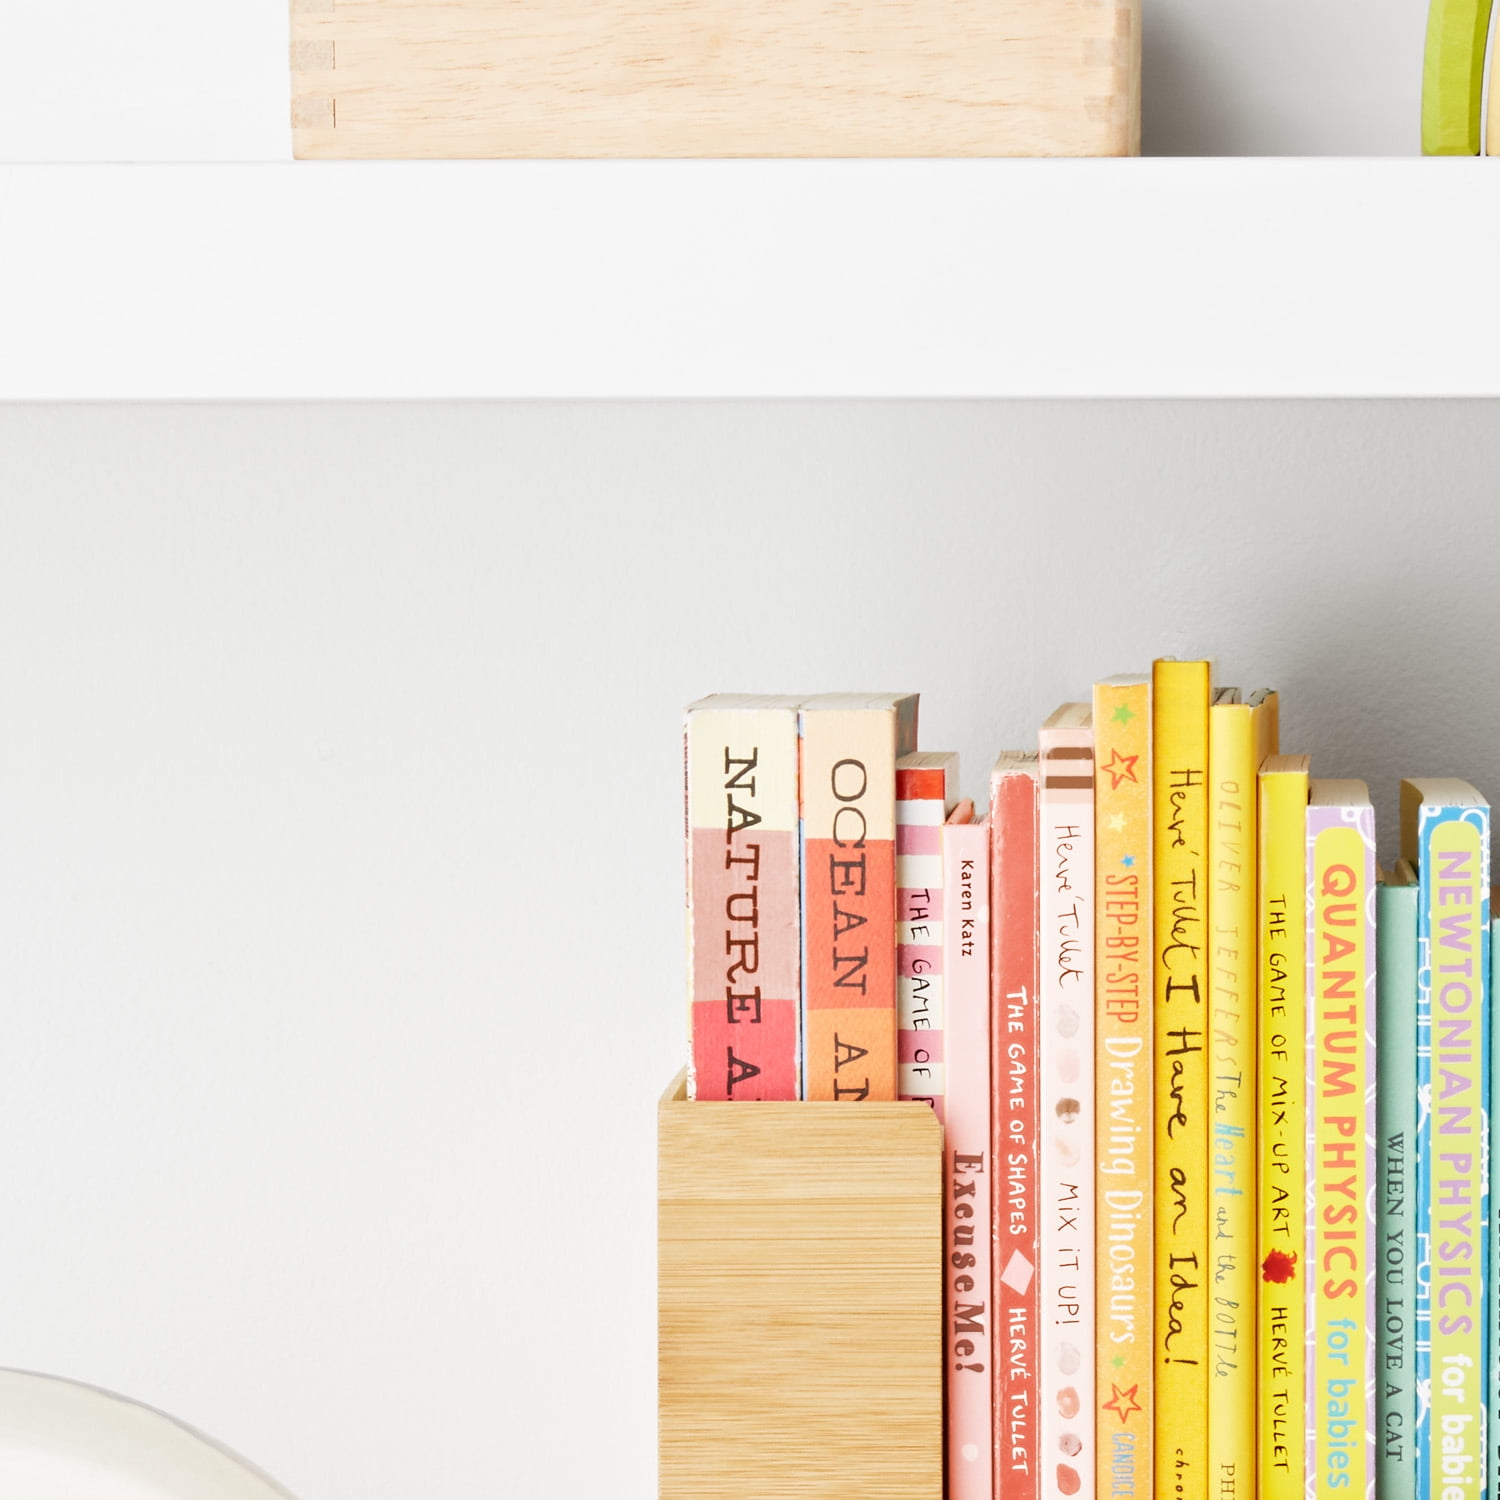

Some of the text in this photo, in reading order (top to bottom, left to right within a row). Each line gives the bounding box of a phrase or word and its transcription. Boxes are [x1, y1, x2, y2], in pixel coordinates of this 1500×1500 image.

[724, 746, 762, 1023] NATURE
[830, 758, 868, 996] OCEAN
[911, 888, 930, 940] THE
[960, 860, 975, 957] Karen Katz
[1269, 894, 1286, 940] THE
[1057, 903, 1084, 989] Tullet
[1162, 869, 1202, 971] Tullet
[1214, 781, 1242, 1066] OLIVER JEFFERS
[911, 959, 931, 1031] GAME
[1270, 953, 1288, 1017] GAME
[1438, 851, 1473, 1135] NEWTONIAN
[912, 1049, 931, 1078] OF
[1271, 1034, 1287, 1063] OF
[1006, 986, 1027, 1235] THE GAME OF SHAPES
[1100, 874, 1143, 1344] STEP-BY-STEP Drawing Dinosaurs
[1164, 974, 1202, 1366] I Have an Idea!
[1214, 1122, 1245, 1196] Heart
[1322, 863, 1358, 1488] QUANTUM PHYSICS for babies
[1215, 1206, 1233, 1241] and
[1272, 1185, 1290, 1237] ART
[1438, 1153, 1473, 1335] PHYSICS
[952, 1150, 985, 1373] Excuse Me!
[1215, 1255, 1236, 1285] the
[1385, 1132, 1404, 1462] WHEN YOU LOVE A CAT
[1055, 1286, 1079, 1325] UP!
[1441, 1353, 1473, 1402] for
[1010, 1390, 1029, 1475] TULLET
[1112, 1433, 1135, 1497] CANDICE
[1272, 1390, 1289, 1474] TULLET
